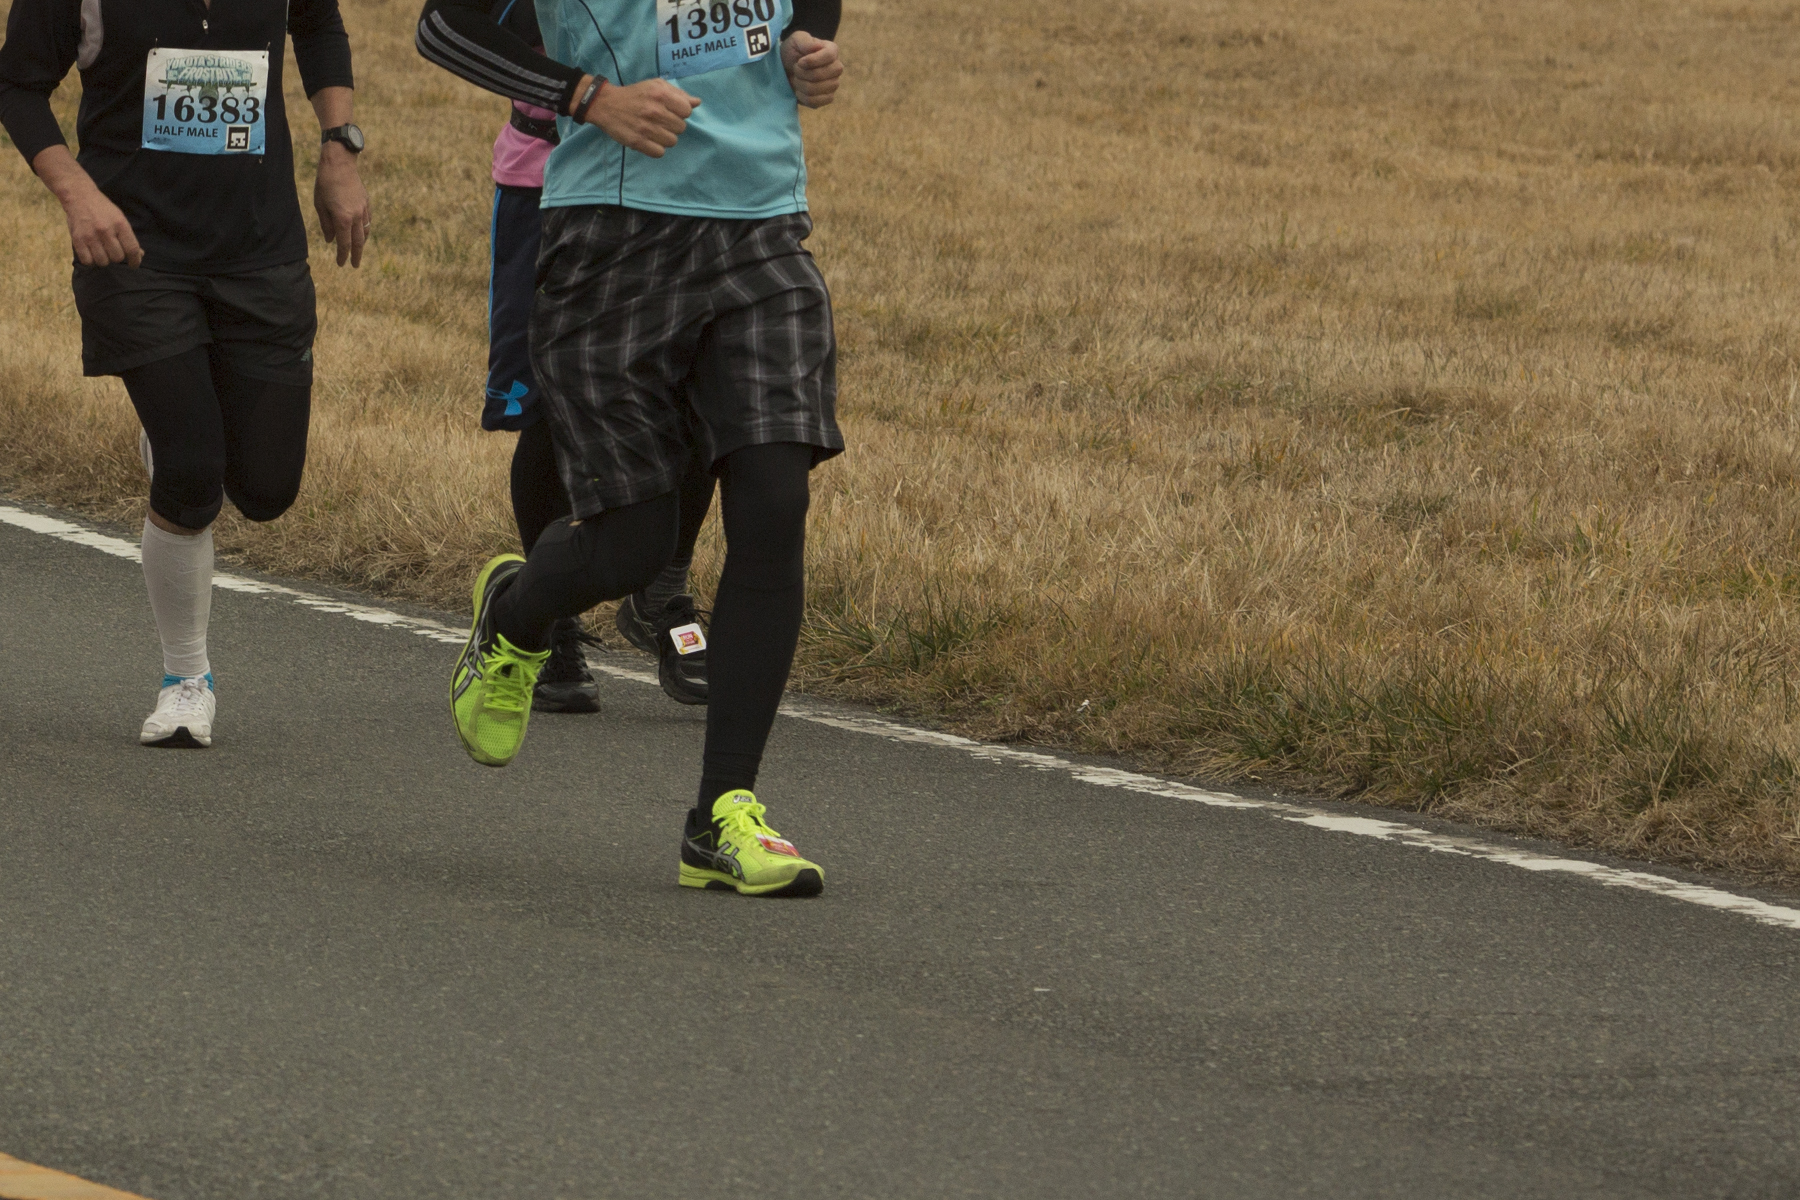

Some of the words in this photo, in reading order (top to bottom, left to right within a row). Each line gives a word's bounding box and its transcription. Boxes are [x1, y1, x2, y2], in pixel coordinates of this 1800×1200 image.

[671, 44, 703, 61] HALF
[704, 36, 738, 53] MALE
[167, 55, 206, 71] YOKOTA
[205, 54, 254, 73] STRIDERS
[178, 66, 240, 82] FROSTBITE
[153, 94, 260, 124] 16383
[154, 125, 184, 136] HALF
[187, 127, 218, 138] MALE
